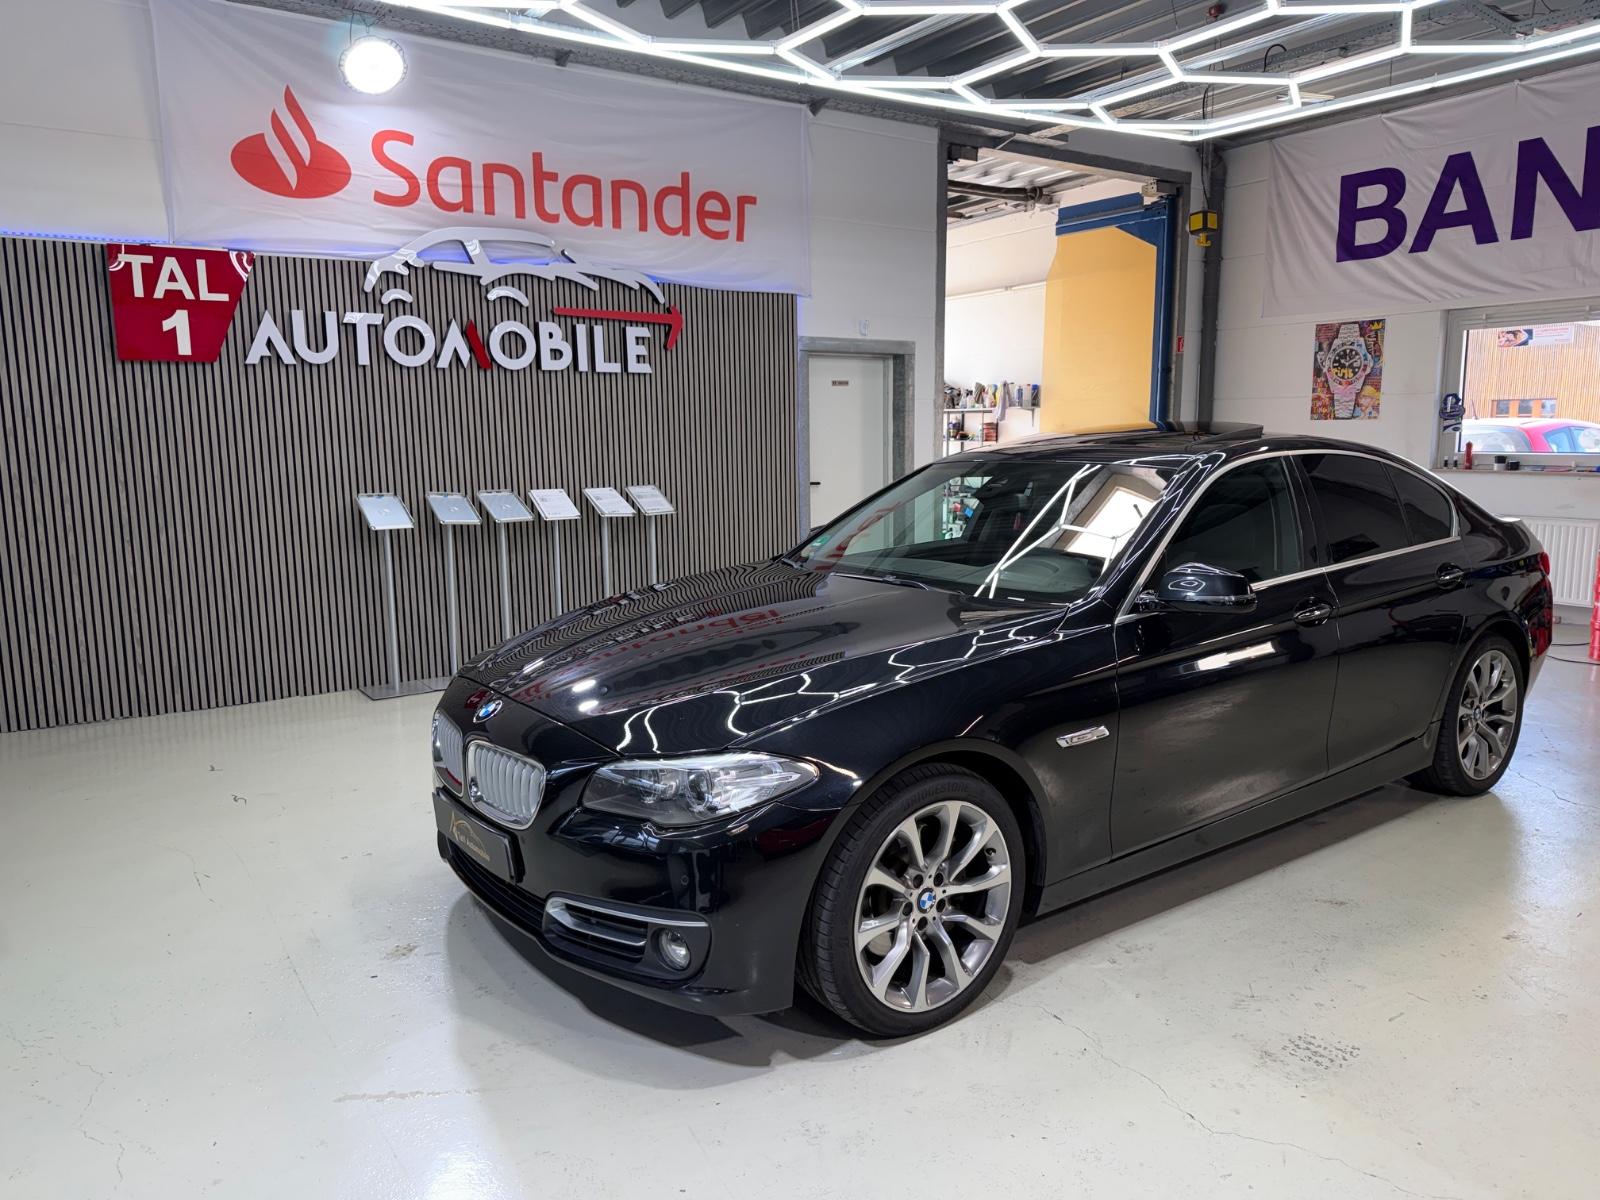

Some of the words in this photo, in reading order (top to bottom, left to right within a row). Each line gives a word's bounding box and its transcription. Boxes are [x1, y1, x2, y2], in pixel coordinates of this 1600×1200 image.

[371, 130, 757, 242] Santander
[1336, 126, 1600, 262] BAN
[118, 254, 229, 302] TAL
[162, 309, 192, 356] 1
[244, 309, 652, 373] AUTOMOBILE
